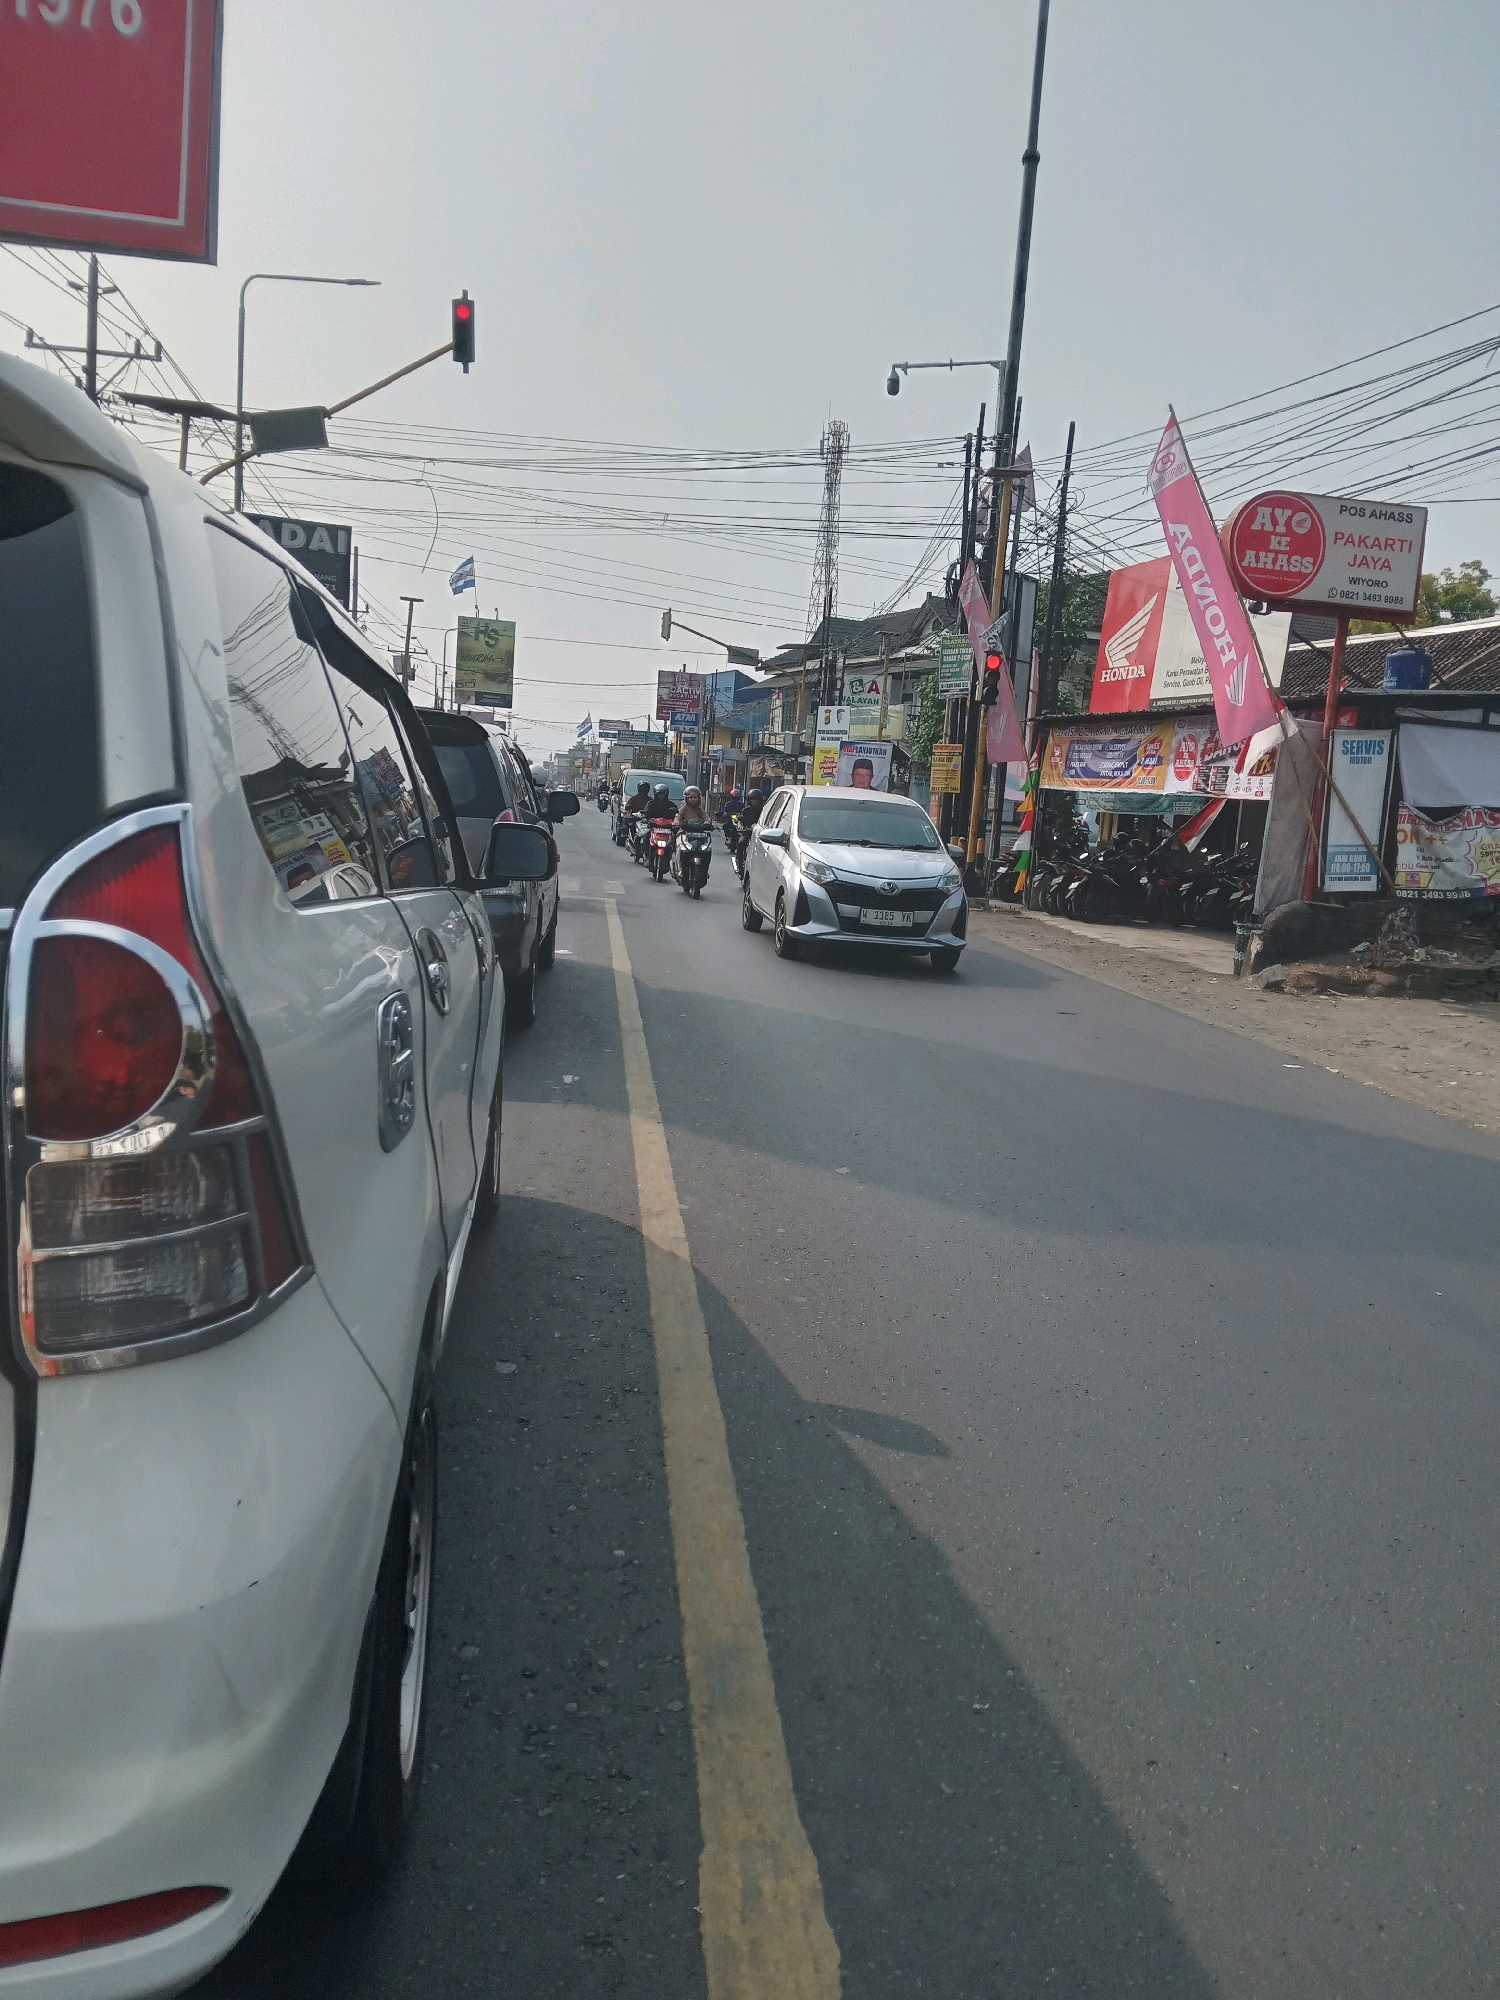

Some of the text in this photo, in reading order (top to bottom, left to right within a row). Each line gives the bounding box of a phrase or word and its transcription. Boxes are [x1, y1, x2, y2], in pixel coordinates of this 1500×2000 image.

[1251, 506, 1312, 534] AYO
[1339, 504, 1414, 524] POS AHASS
[1269, 536, 1290, 551] KE
[1333, 531, 1413, 554] PAKARTI
[1241, 550, 1314, 574] AHASS
[1348, 554, 1392, 572] JAYA
[1348, 576, 1388, 588] WIYORO
[1339, 589, 1359, 601] 0821
[1362, 591, 1381, 603] 3493
[1100, 664, 1146, 683] HONDA
[866, 679, 880, 695] A
[1341, 739, 1385, 756] SERVIS
[1349, 756, 1372, 764] MOTOR
[1396, 889, 1418, 898] 0821
[1422, 891, 1444, 899] 3493
